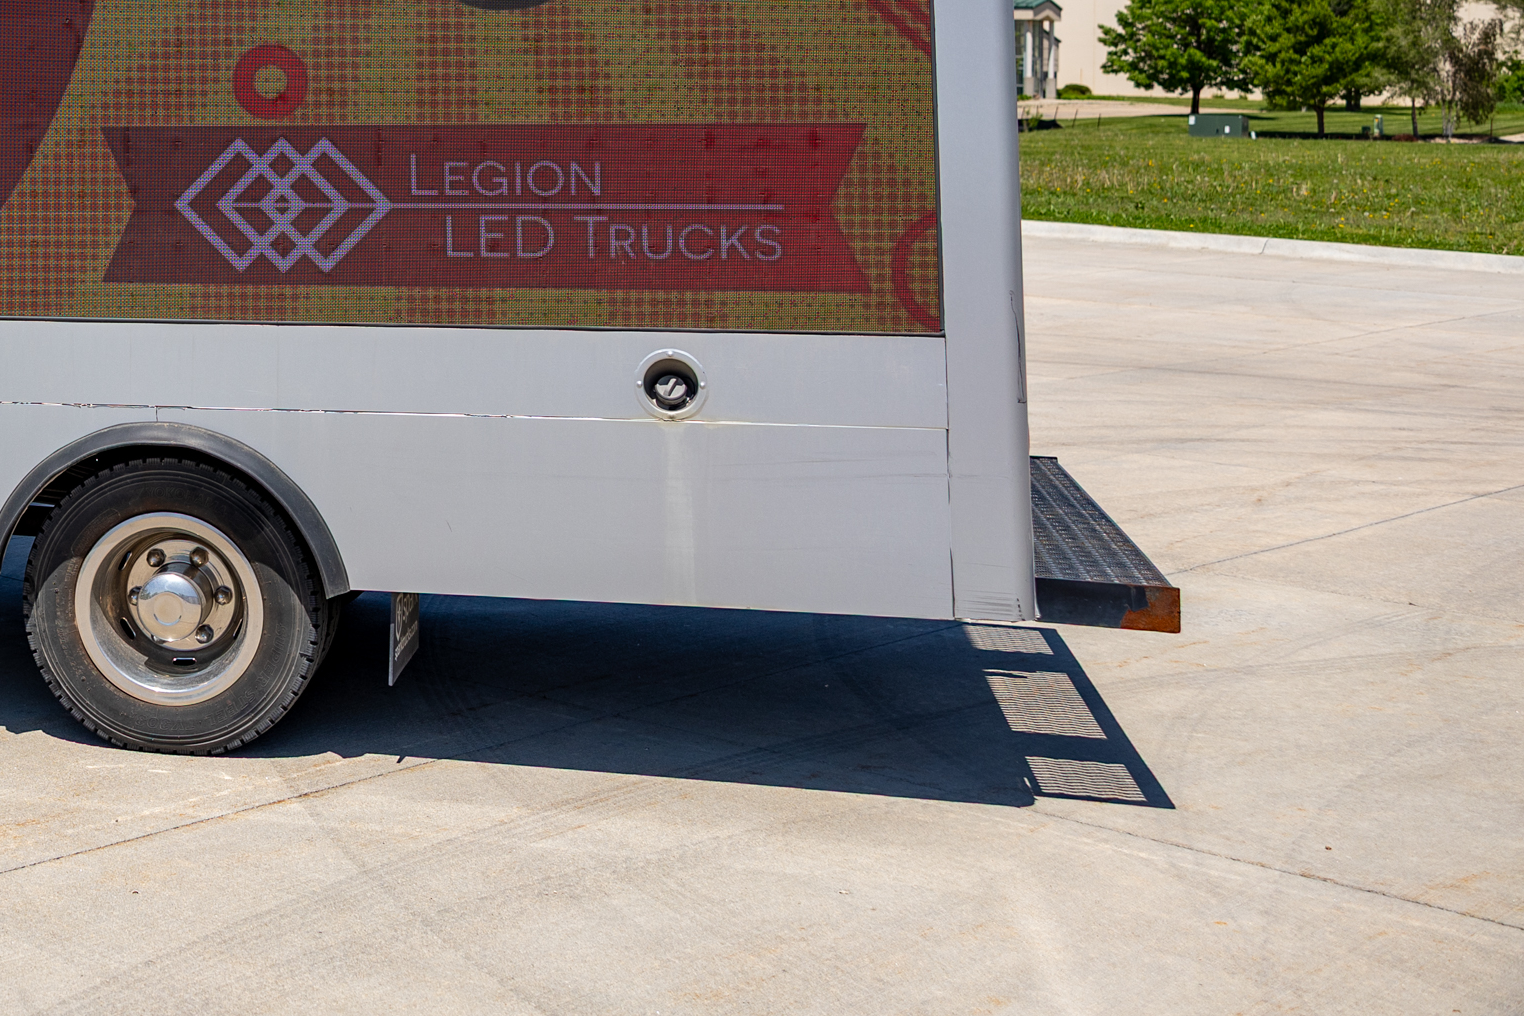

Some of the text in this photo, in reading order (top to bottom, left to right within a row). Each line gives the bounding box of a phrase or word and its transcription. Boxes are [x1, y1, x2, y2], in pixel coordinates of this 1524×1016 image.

[409, 153, 602, 196] LEGION
[445, 215, 783, 262] LED TRUCKS
